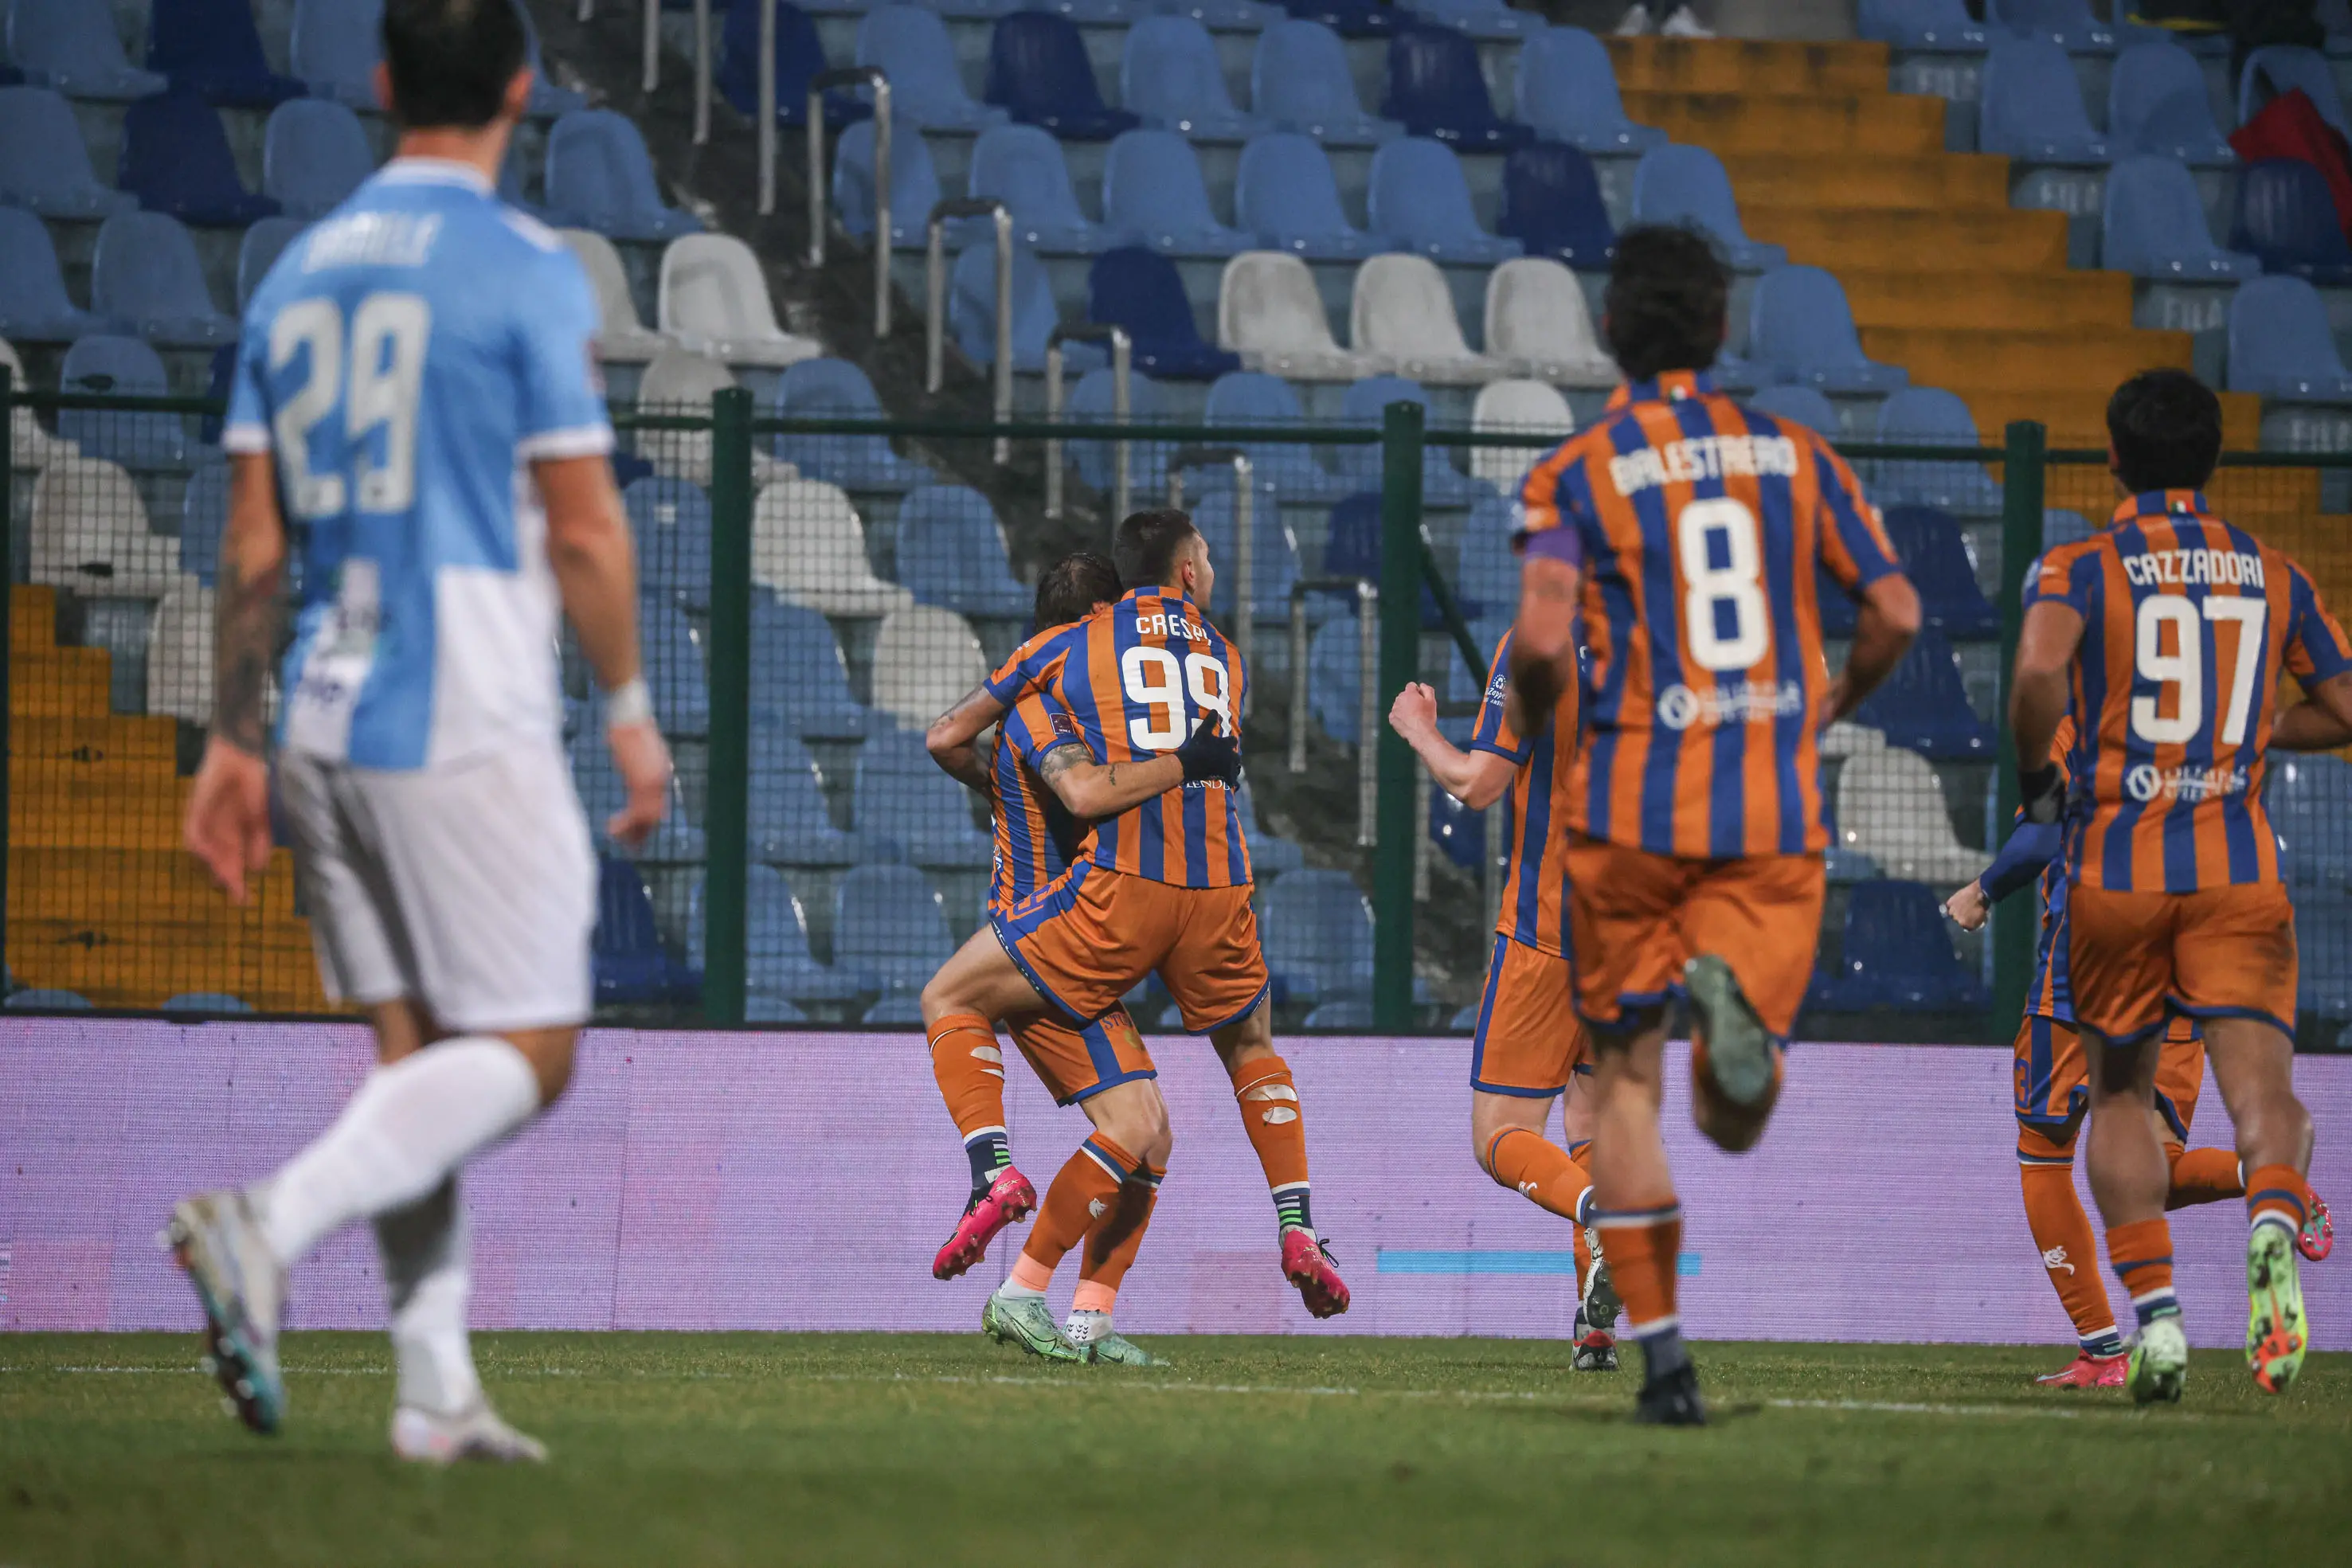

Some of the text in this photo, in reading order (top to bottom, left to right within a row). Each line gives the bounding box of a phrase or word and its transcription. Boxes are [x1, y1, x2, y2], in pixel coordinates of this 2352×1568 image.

[268, 291, 431, 519] 29
[1678, 497, 1769, 671] 8
[2123, 548, 2265, 589] CAZZADORI
[1121, 646, 1231, 750] 99
[2131, 593, 2268, 745] 97
